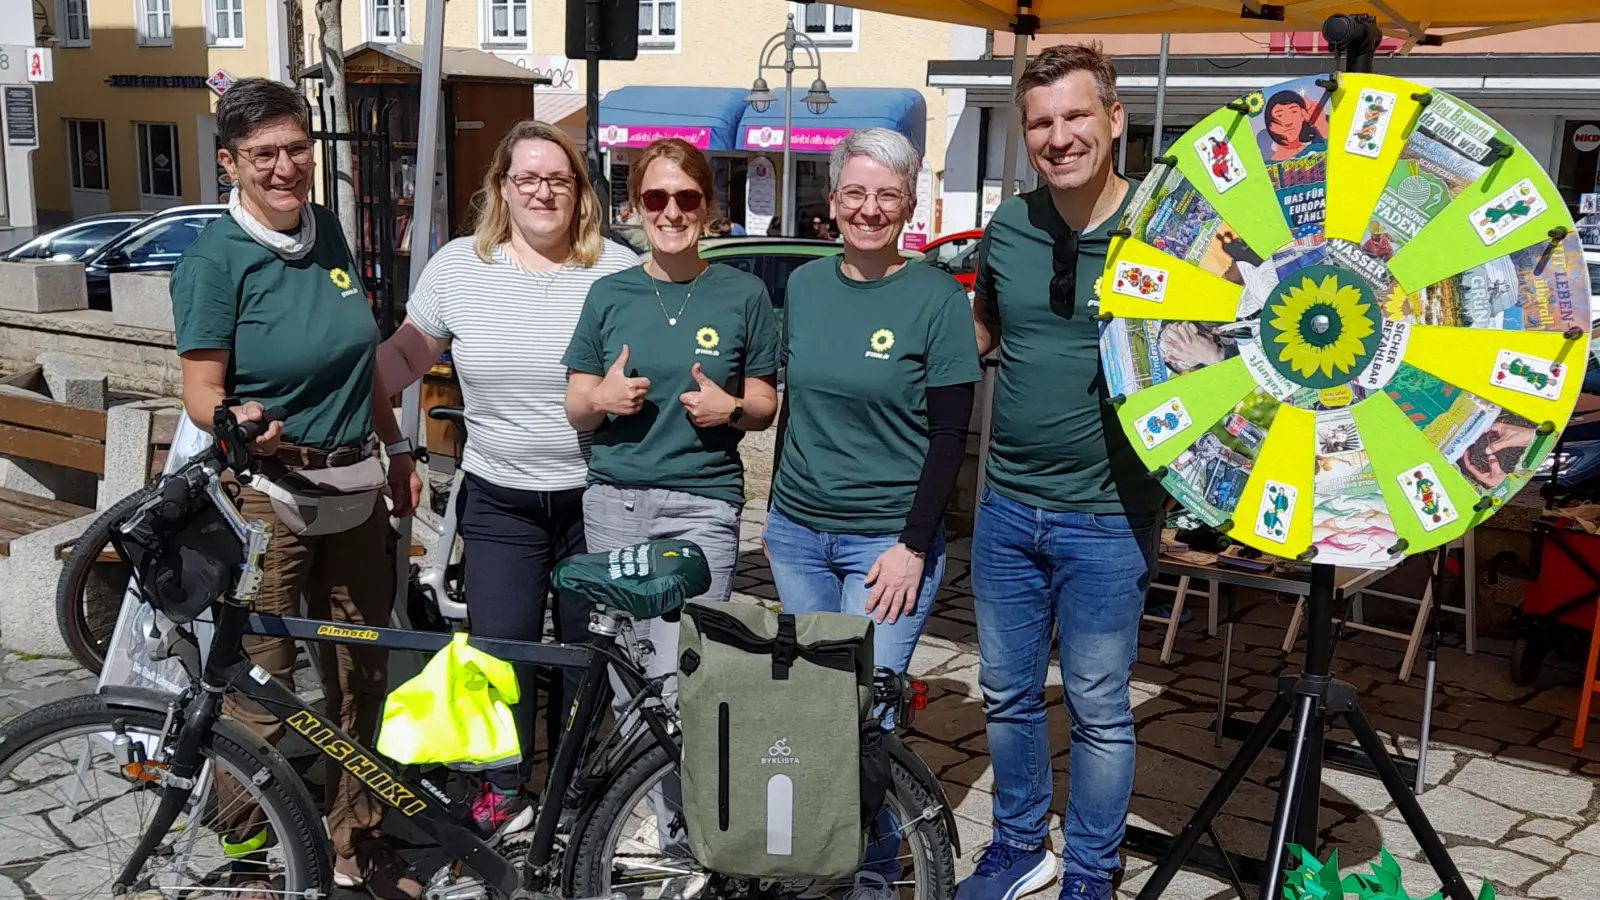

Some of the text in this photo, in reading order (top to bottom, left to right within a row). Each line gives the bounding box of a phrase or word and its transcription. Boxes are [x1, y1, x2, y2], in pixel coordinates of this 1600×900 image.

[1420, 112, 1489, 160] da geht was!
[1574, 134, 1600, 142] NKD
[1284, 188, 1324, 206] WAS FÜR
[1290, 198, 1326, 216] EUROPA
[1298, 210, 1326, 224] ZÄHLT
[1380, 192, 1429, 226] DER GRÜNE
[1374, 200, 1424, 238] FADEN
[1330, 236, 1386, 278] WASSER
[1146, 319, 1162, 383] Windenergie
[1368, 319, 1393, 385] BEZAHLBAR
[1385, 322, 1405, 364] SICHER
[1247, 353, 1284, 400] Zukunft
[286, 710, 428, 816] NISHIKI
